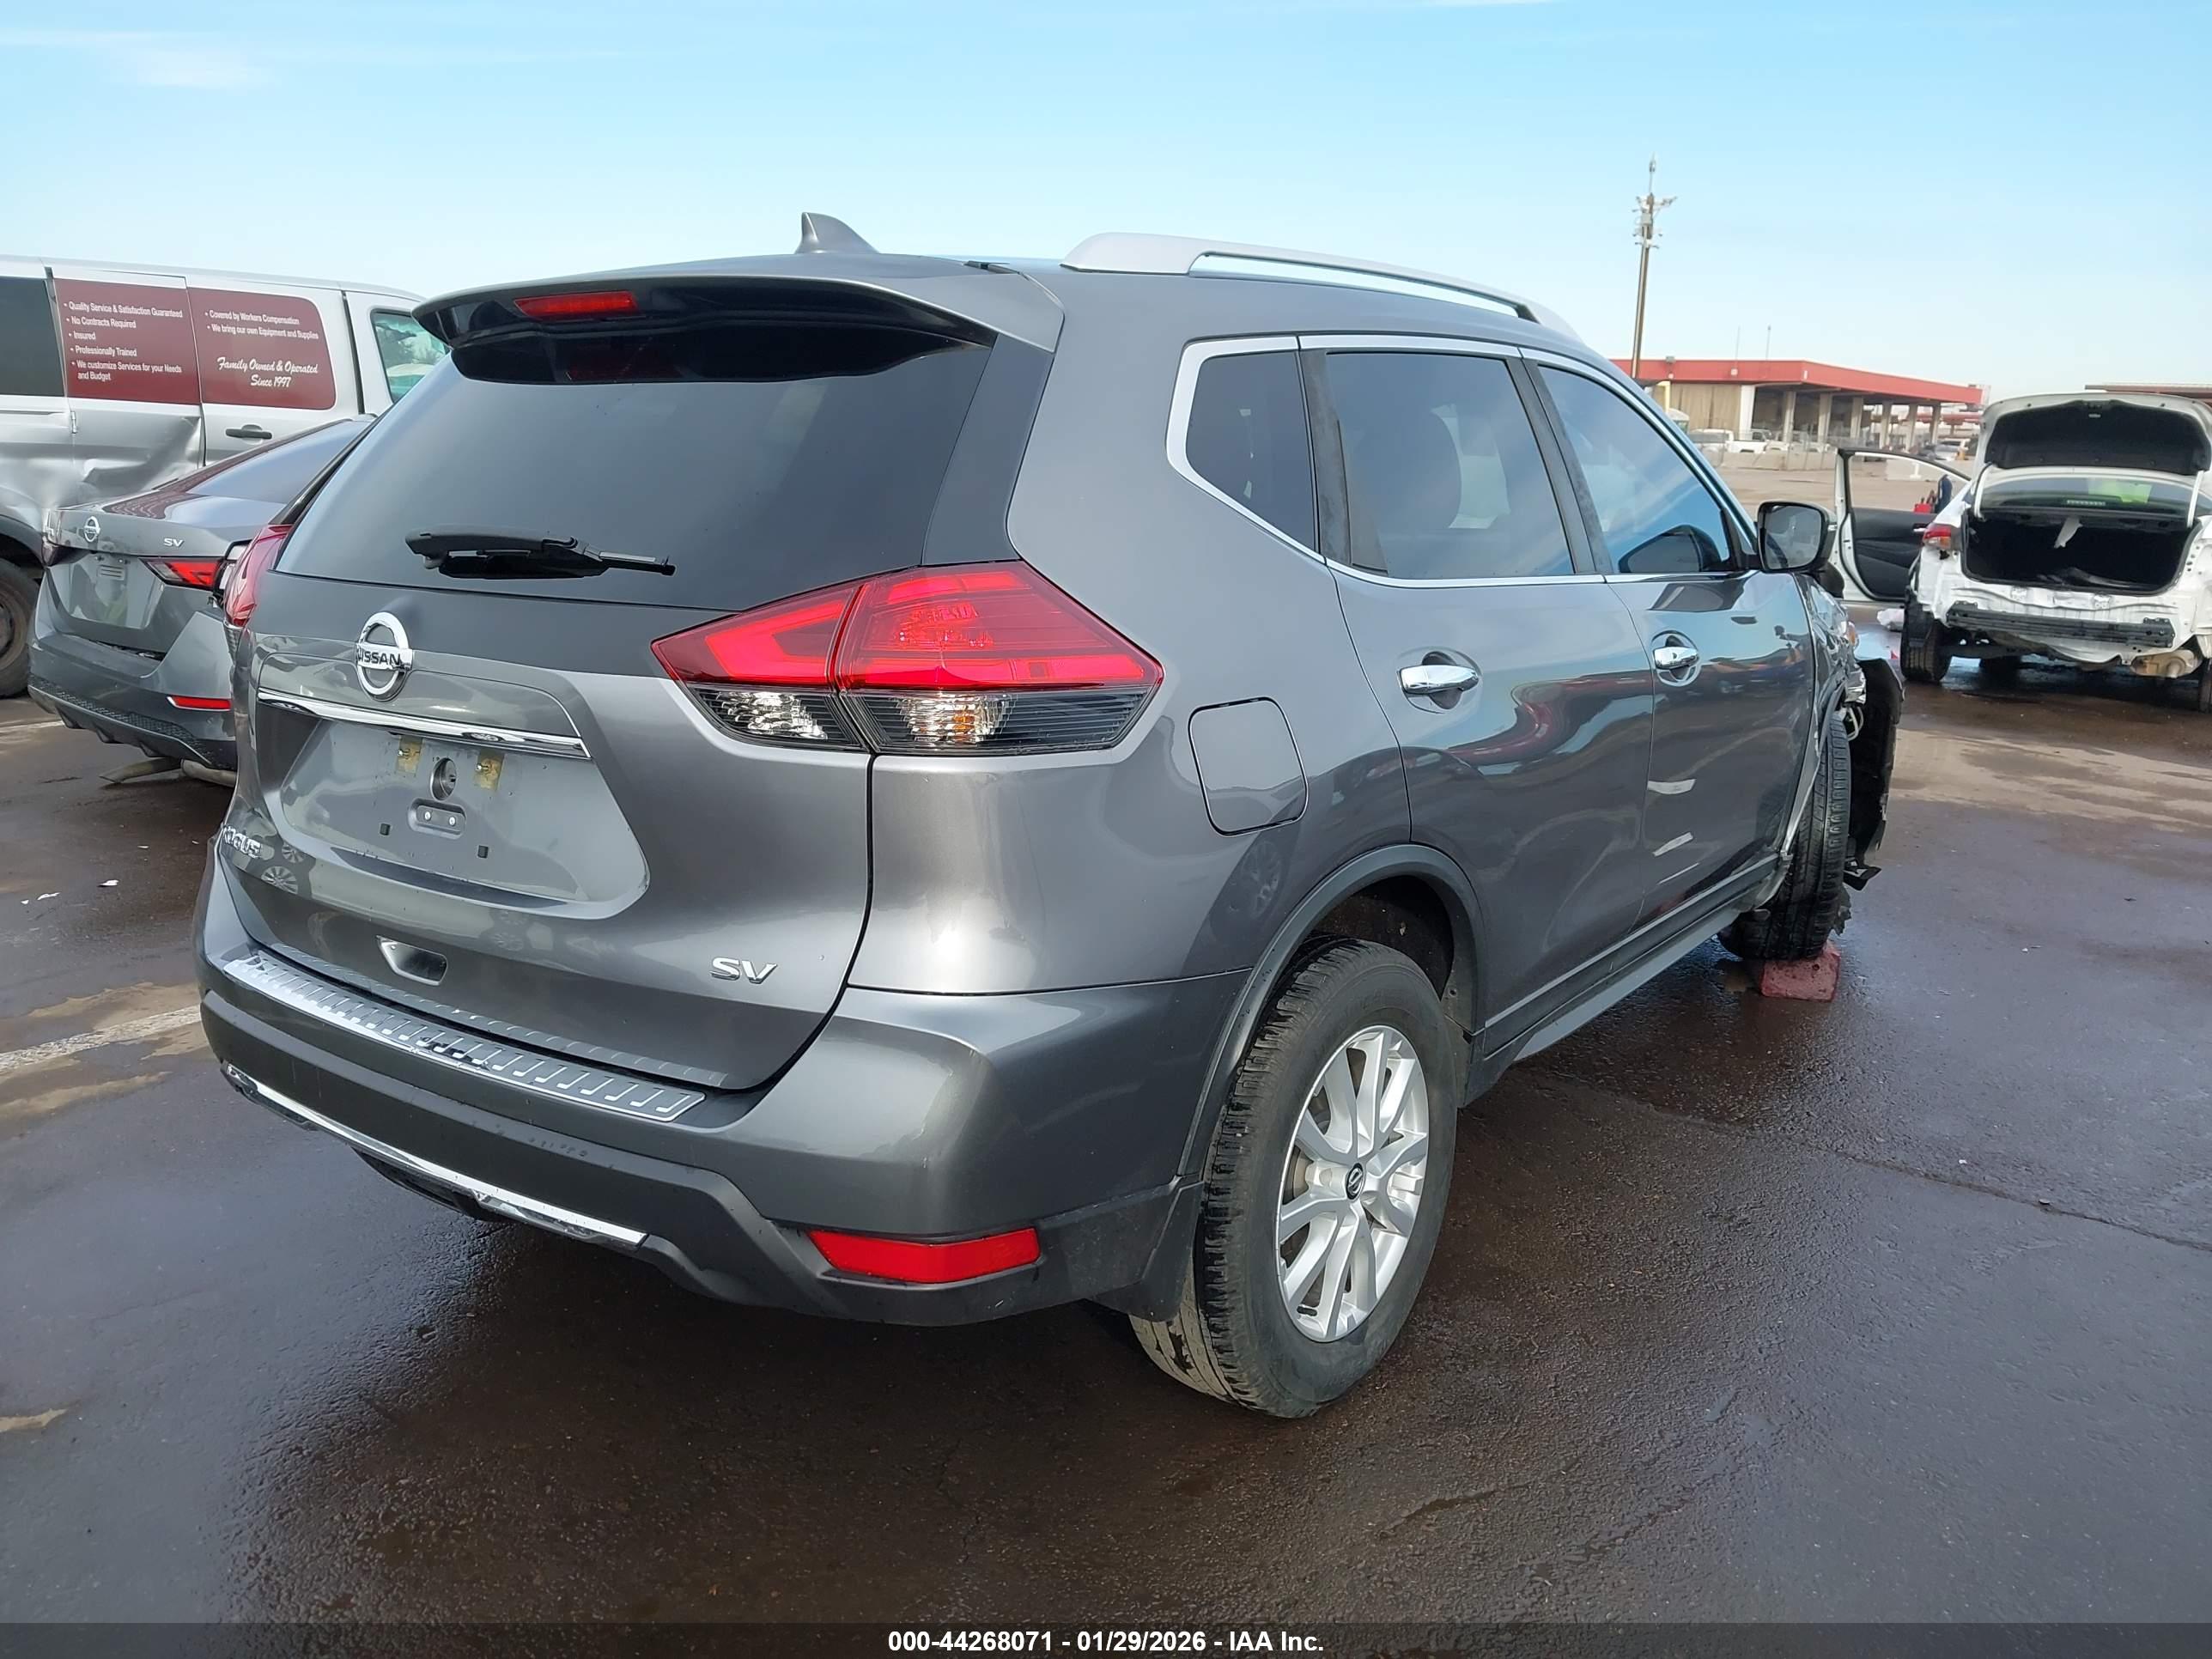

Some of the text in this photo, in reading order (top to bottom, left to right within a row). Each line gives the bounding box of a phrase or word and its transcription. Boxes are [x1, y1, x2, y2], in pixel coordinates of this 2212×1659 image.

[69, 301, 183, 318] Quality Service & Satisfaction Guaranteed
[71, 316, 136, 328] No Contracts Required
[210, 310, 300, 325] Covered by Workers Compensation
[74, 330, 96, 339] Insured
[211, 323, 221, 331] We
[222, 325, 236, 334] bring
[258, 326, 286, 337] Equipment
[297, 331, 319, 340] Supplies
[76, 345, 137, 357] Professionally Trained
[76, 359, 87, 368] We
[88, 361, 117, 369] customize
[118, 362, 142, 371] Services
[151, 365, 163, 374] your
[164, 364, 182, 373] Needs
[217, 356, 318, 374] Family Owned & Operated
[90, 371, 111, 381] Budget
[251, 374, 291, 387] Since 1997
[164, 538, 185, 547] SV
[356, 647, 400, 665] NISSAN
[709, 957, 778, 984] SV
